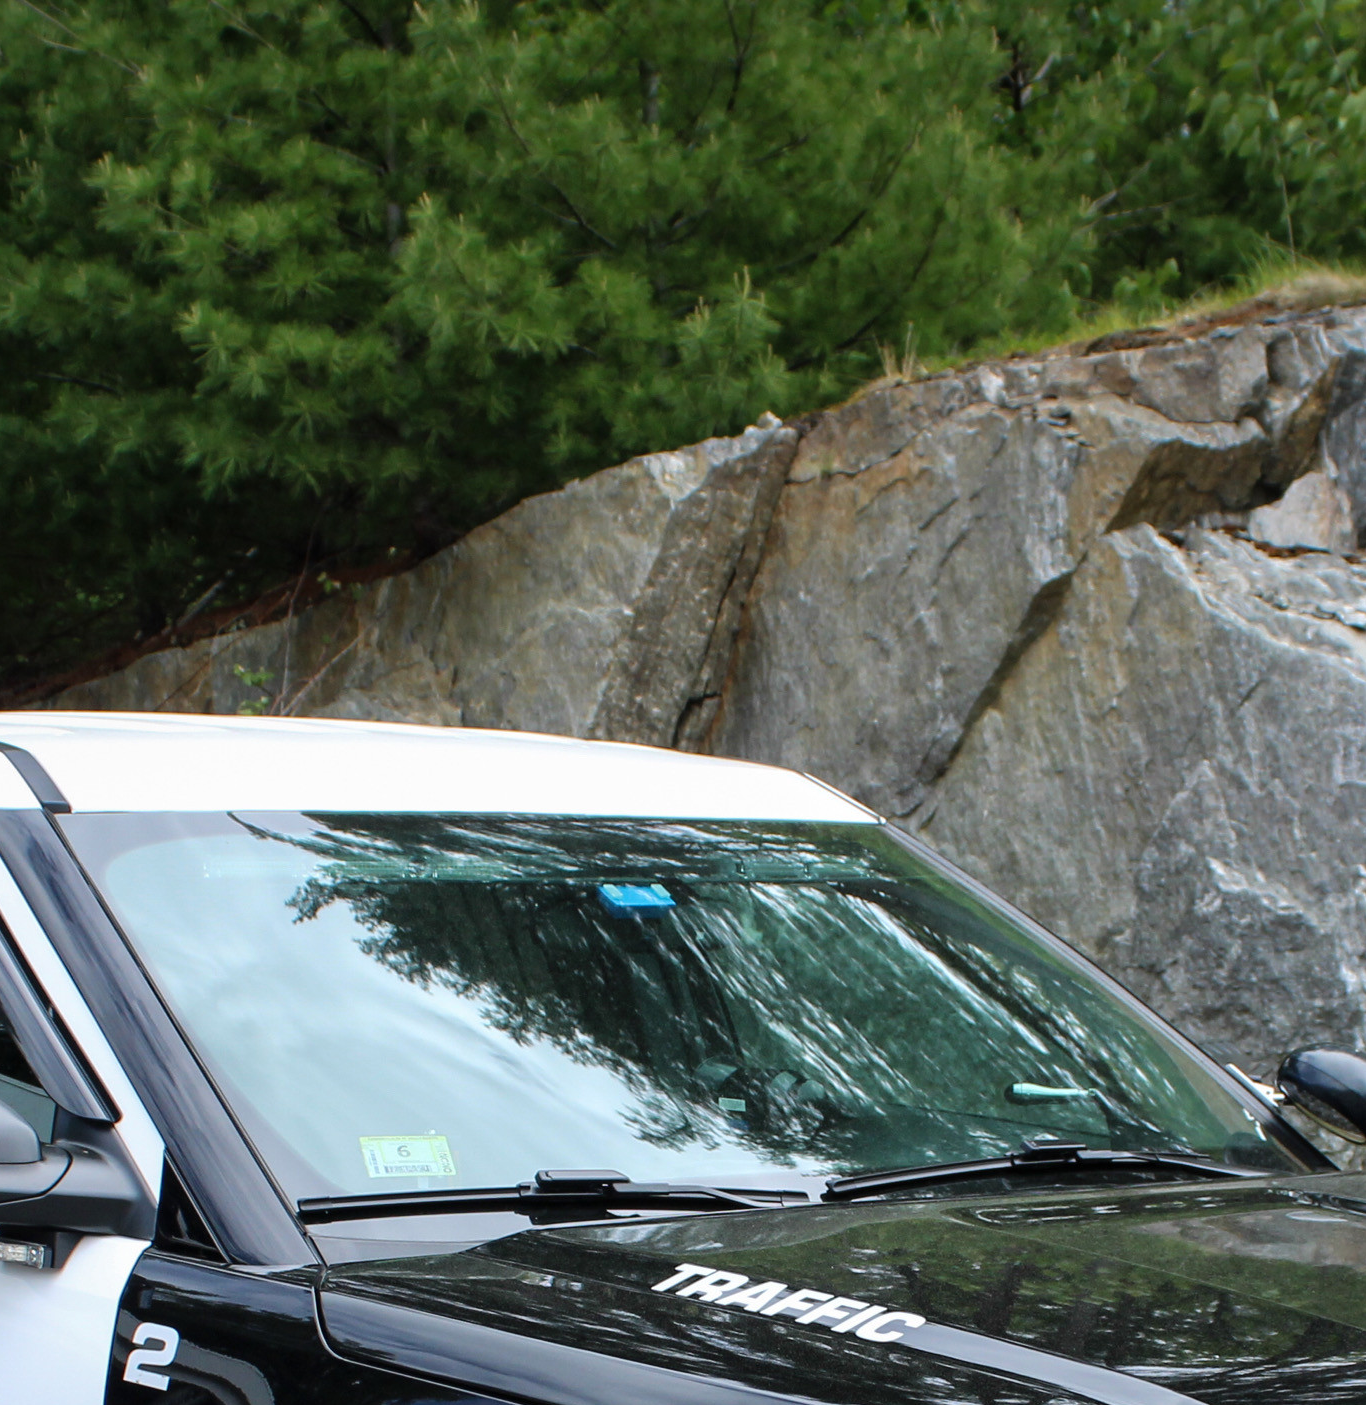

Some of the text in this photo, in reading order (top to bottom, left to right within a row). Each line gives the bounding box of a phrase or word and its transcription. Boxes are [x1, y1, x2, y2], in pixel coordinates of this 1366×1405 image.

[396, 1144, 412, 1158] 6
[650, 1262, 927, 1343] TRAFFIC
[122, 1321, 181, 1392] 2
